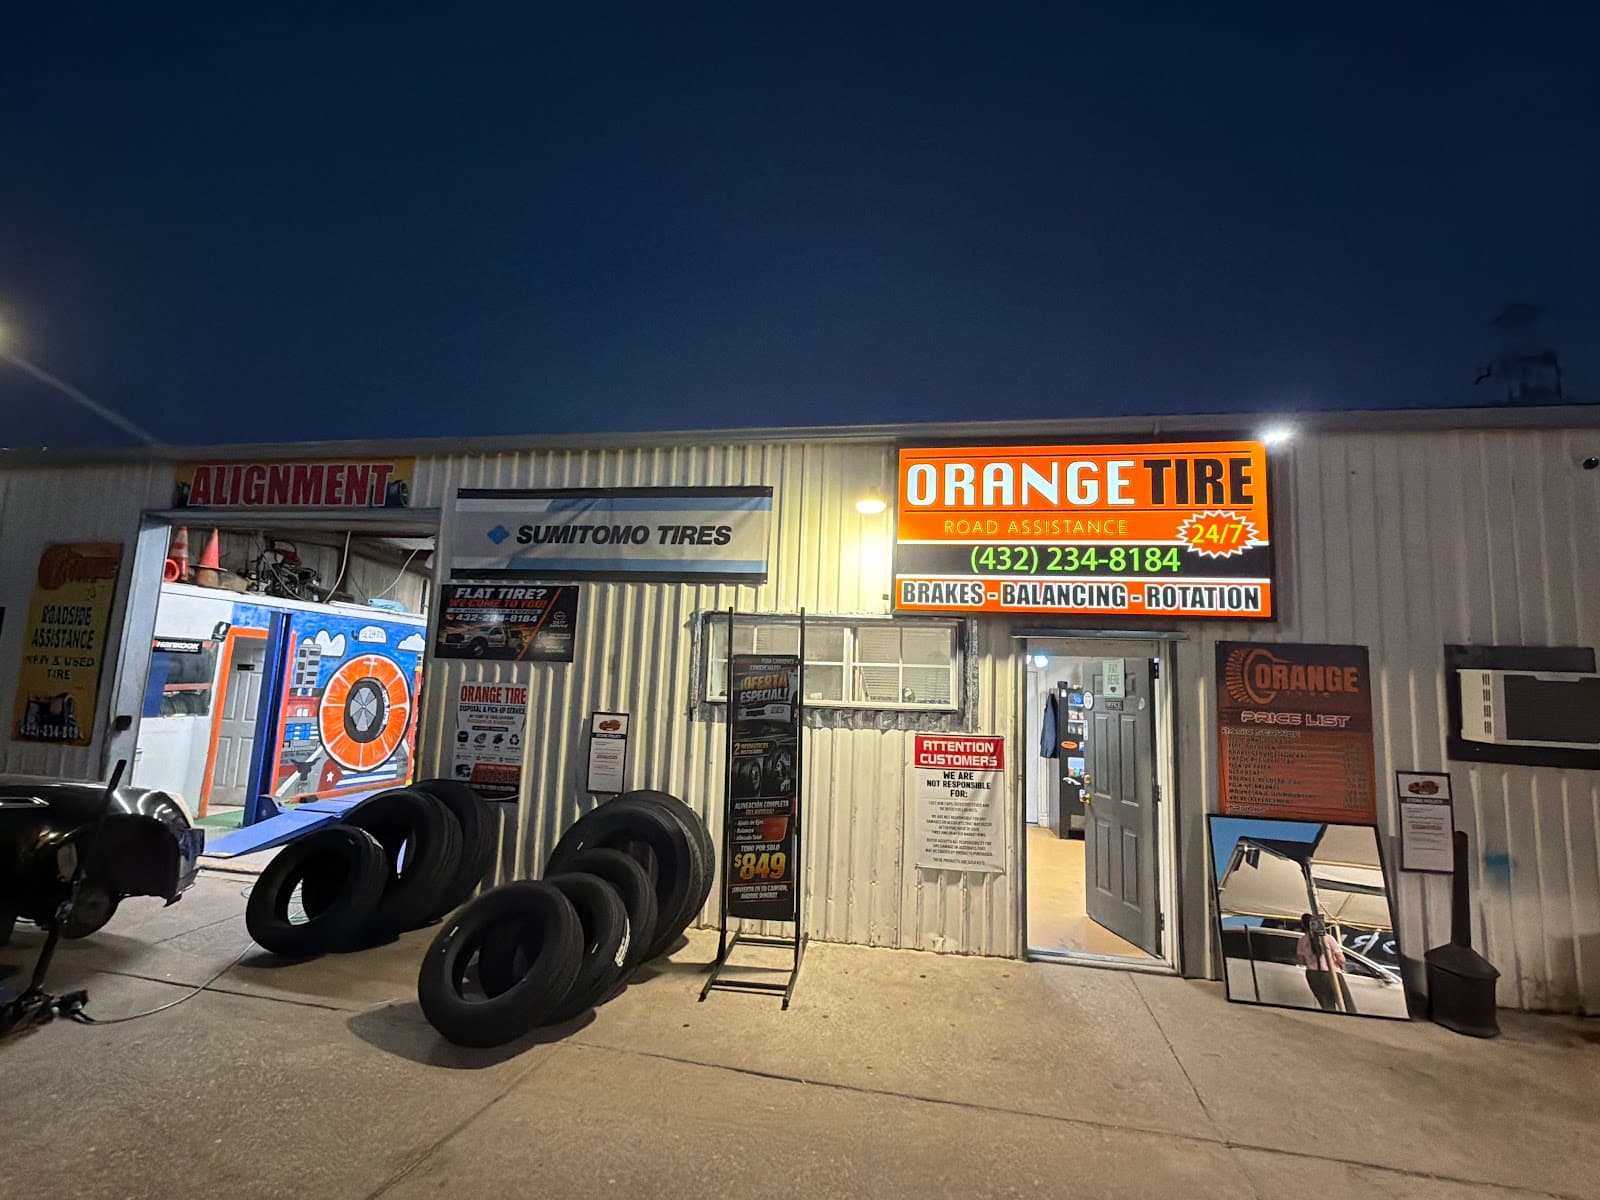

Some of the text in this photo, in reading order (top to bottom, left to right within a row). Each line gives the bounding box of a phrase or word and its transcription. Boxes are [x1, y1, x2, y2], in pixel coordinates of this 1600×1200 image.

[188, 463, 395, 507] ALIGNMENT
[906, 457, 1254, 508] ORANGE TIRE
[516, 525, 732, 546] SUMITOMO TIRES
[944, 519, 1129, 536] ROAD ASSISTANCE
[1191, 523, 1243, 545] 24/7
[970, 545, 1181, 575] (432) 234-8184
[455, 587, 547, 600] FLAT TIRE?
[902, 582, 985, 606] BRAKES
[1001, 583, 1129, 610] BALANCING
[1145, 585, 1262, 611] ROTATION
[41, 605, 93, 626] ROADSIDE
[31, 628, 96, 649] ASSISTANCE
[47, 669, 71, 681] TIRE
[1255, 663, 1359, 693] ORANGE
[460, 685, 527, 705] ORANGE TIRE
[1241, 710, 1350, 728] PRICE LIST
[922, 740, 994, 753] ATTENTION
[920, 754, 998, 767] CUSTOMERS
[942, 781, 992, 789] RESPONSIBLE
[943, 771, 974, 780] WE ARE
[950, 789, 968, 798] FOR:
[734, 852, 787, 880] $849
